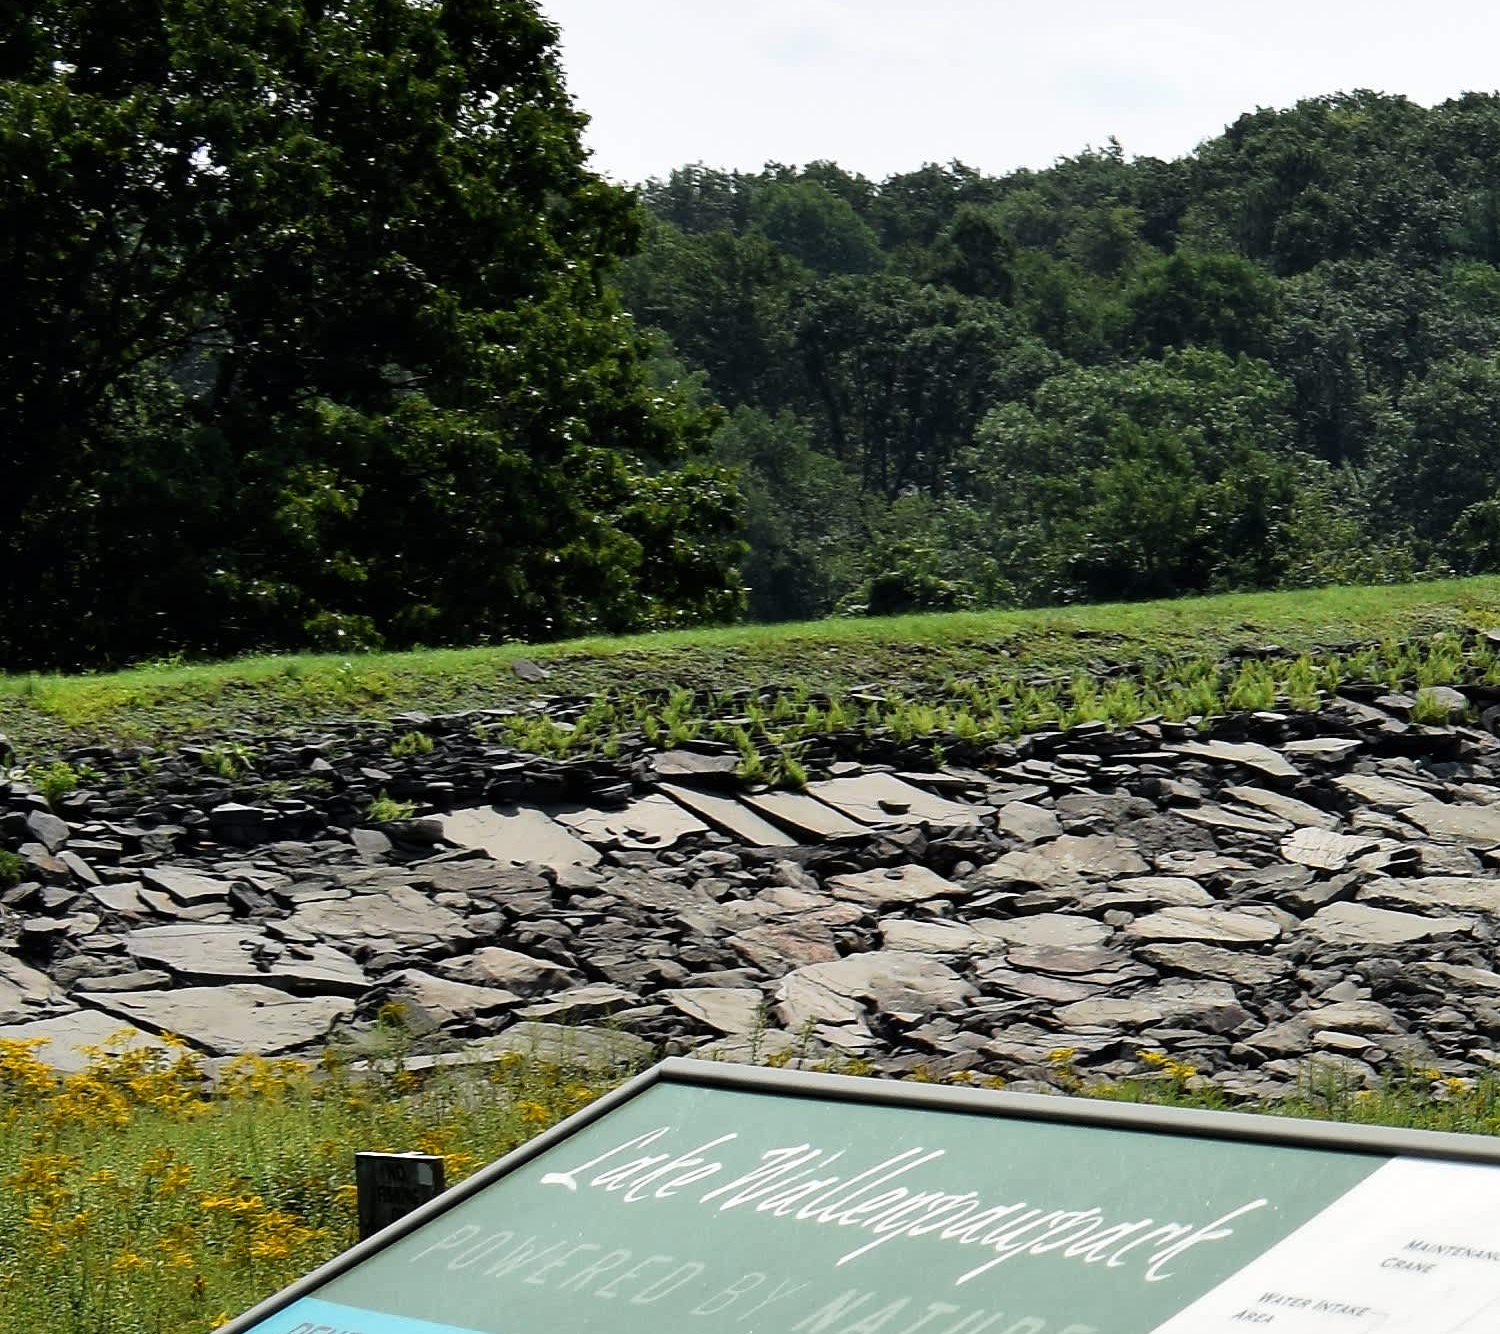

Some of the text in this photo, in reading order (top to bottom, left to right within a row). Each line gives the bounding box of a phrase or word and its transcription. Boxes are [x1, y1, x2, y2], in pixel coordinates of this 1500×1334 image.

[540, 1126, 1268, 1286] Lake Wallenpaupack
[408, 1224, 705, 1304] POWERED
[690, 1272, 812, 1322] BY
[1380, 1257, 1437, 1274] CRANE
[1232, 1309, 1275, 1324] AREA
[1258, 1291, 1371, 1317] WATER INTAKE
